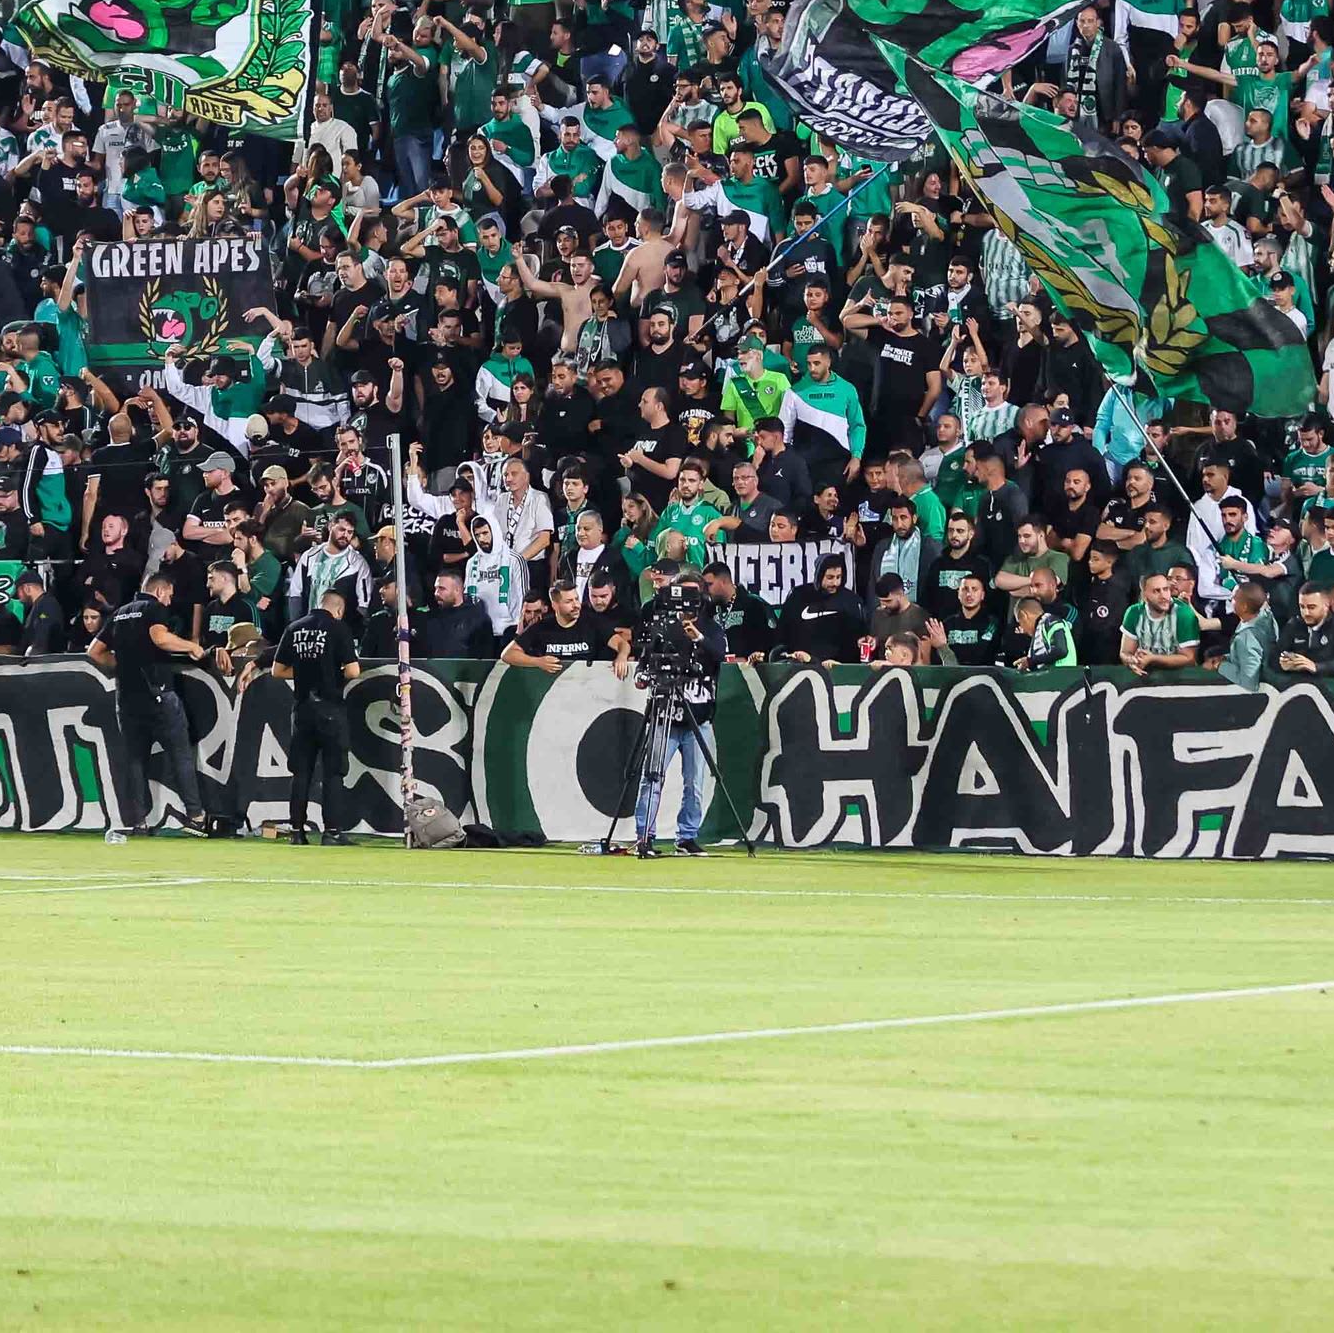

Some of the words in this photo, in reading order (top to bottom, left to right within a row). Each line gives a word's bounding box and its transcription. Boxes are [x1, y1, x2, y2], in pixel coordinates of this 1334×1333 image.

[187, 95, 235, 123] APES
[92, 243, 183, 277] GREEN
[193, 239, 263, 273] APES
[546, 642, 589, 653] INFERNO
